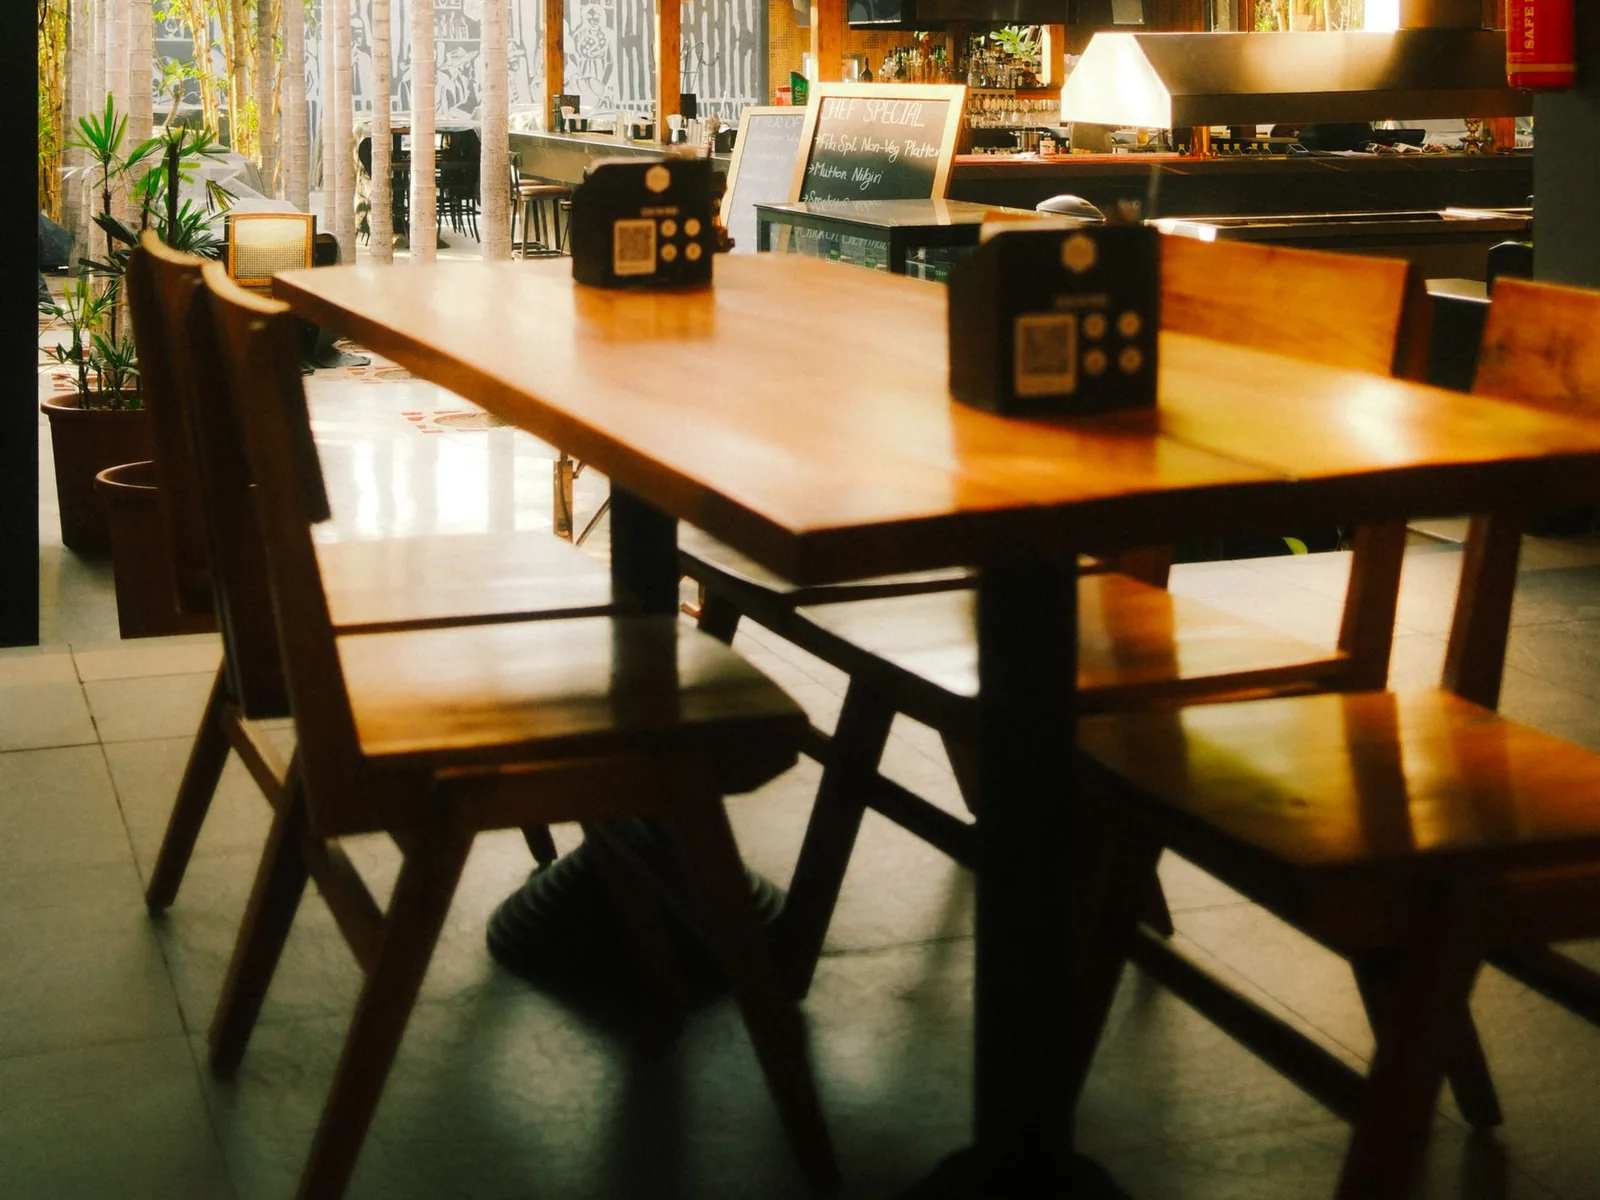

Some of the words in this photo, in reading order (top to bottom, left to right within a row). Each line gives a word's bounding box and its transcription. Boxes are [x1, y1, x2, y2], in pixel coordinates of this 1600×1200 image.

[1524, 6, 1535, 50] SAFE
[821, 98, 855, 120] CHEF
[863, 99, 925, 127] SPECIAL
[838, 134, 857, 157] Spl.
[860, 136, 900, 163] Non-Veg
[904, 139, 940, 158] Platter
[813, 161, 847, 180] Mutton
